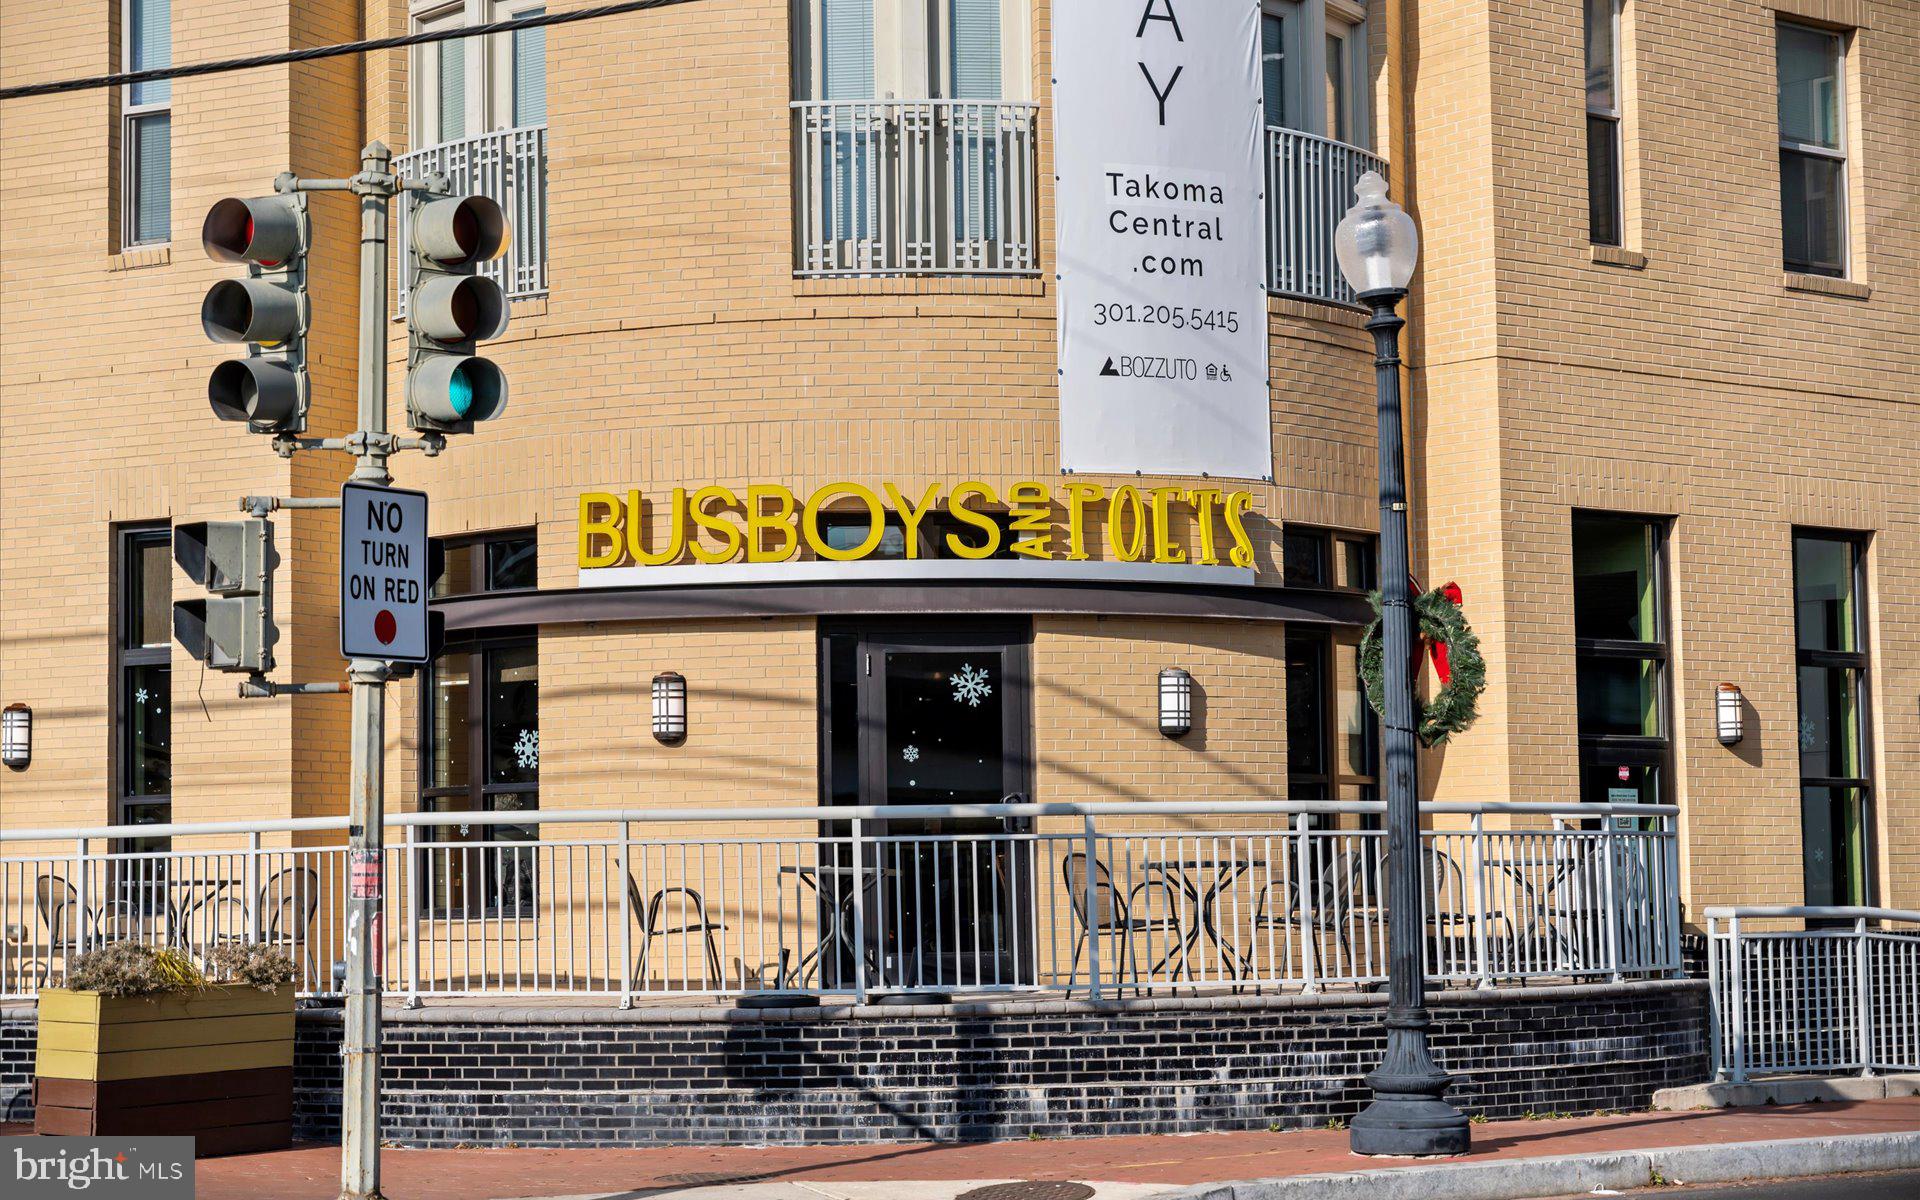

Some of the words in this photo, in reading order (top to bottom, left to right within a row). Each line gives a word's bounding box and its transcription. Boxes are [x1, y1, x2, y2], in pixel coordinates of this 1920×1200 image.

[1105, 172, 1224, 205] Takoma
[1109, 209, 1223, 241] Central
[1133, 254, 1203, 277] .com
[1093, 303, 1239, 333] 301.205.5415
[1120, 355, 1197, 381] BOZZUTO
[367, 500, 403, 534] NO
[578, 481, 1001, 568] BUSBOYS
[1008, 481, 1053, 560] AND
[1062, 482, 1256, 568] POETS
[361, 540, 409, 569] TURN
[350, 574, 375, 601] ON
[384, 577, 419, 604] RED
